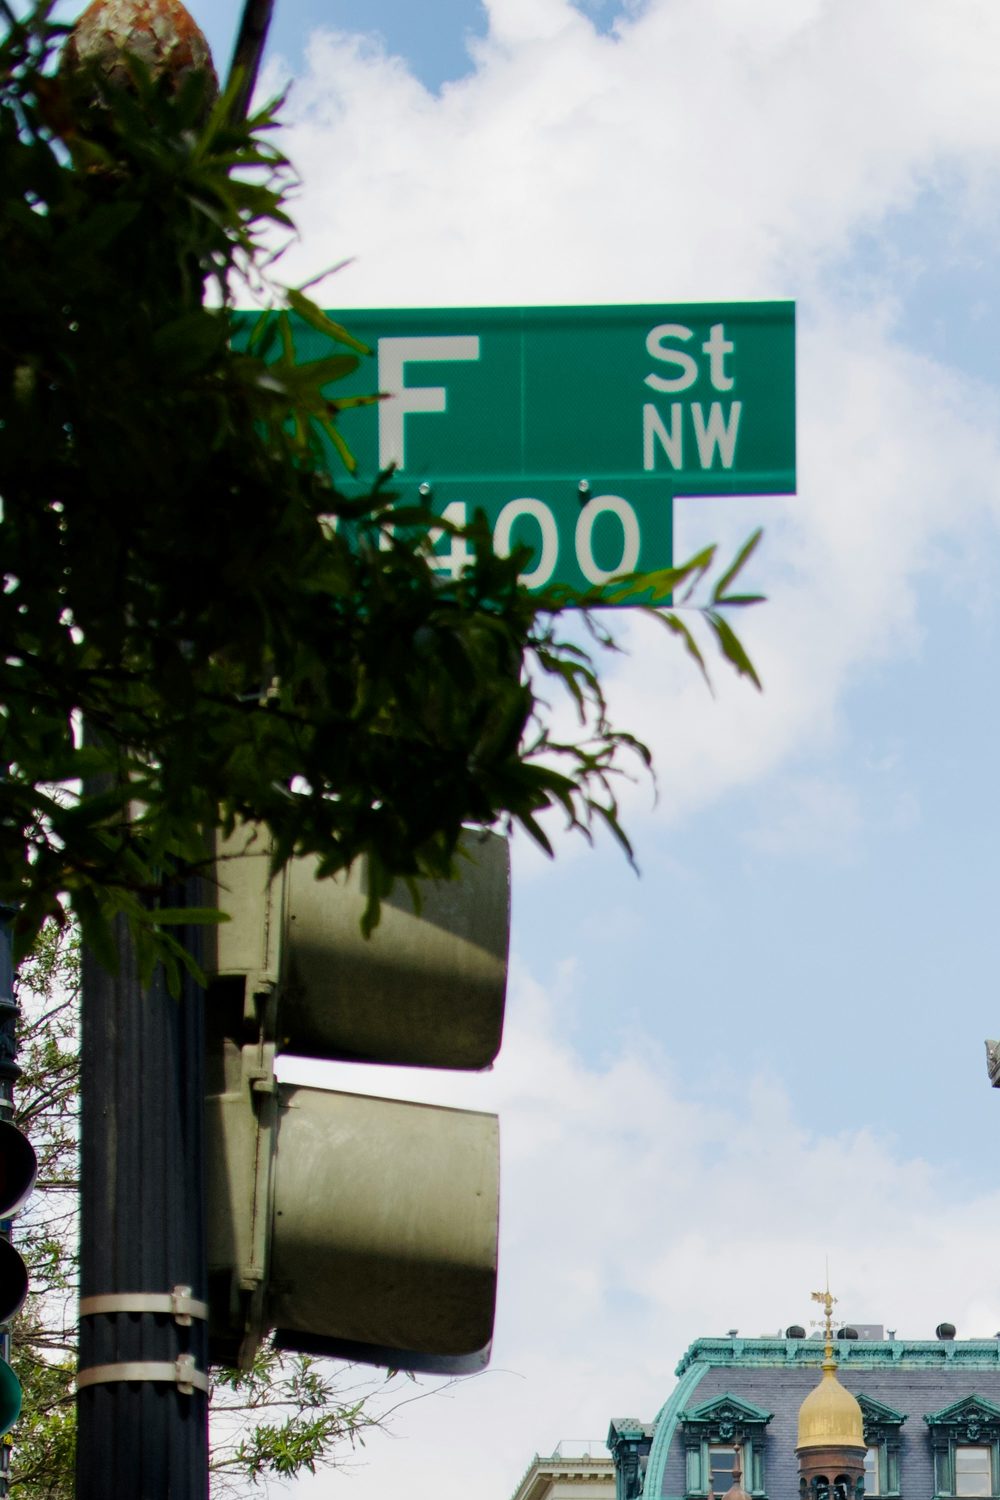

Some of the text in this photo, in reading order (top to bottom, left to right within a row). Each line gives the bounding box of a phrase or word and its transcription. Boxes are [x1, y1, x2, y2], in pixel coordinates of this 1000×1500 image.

[378, 323, 734, 470] F St
[643, 401, 742, 471] NW
